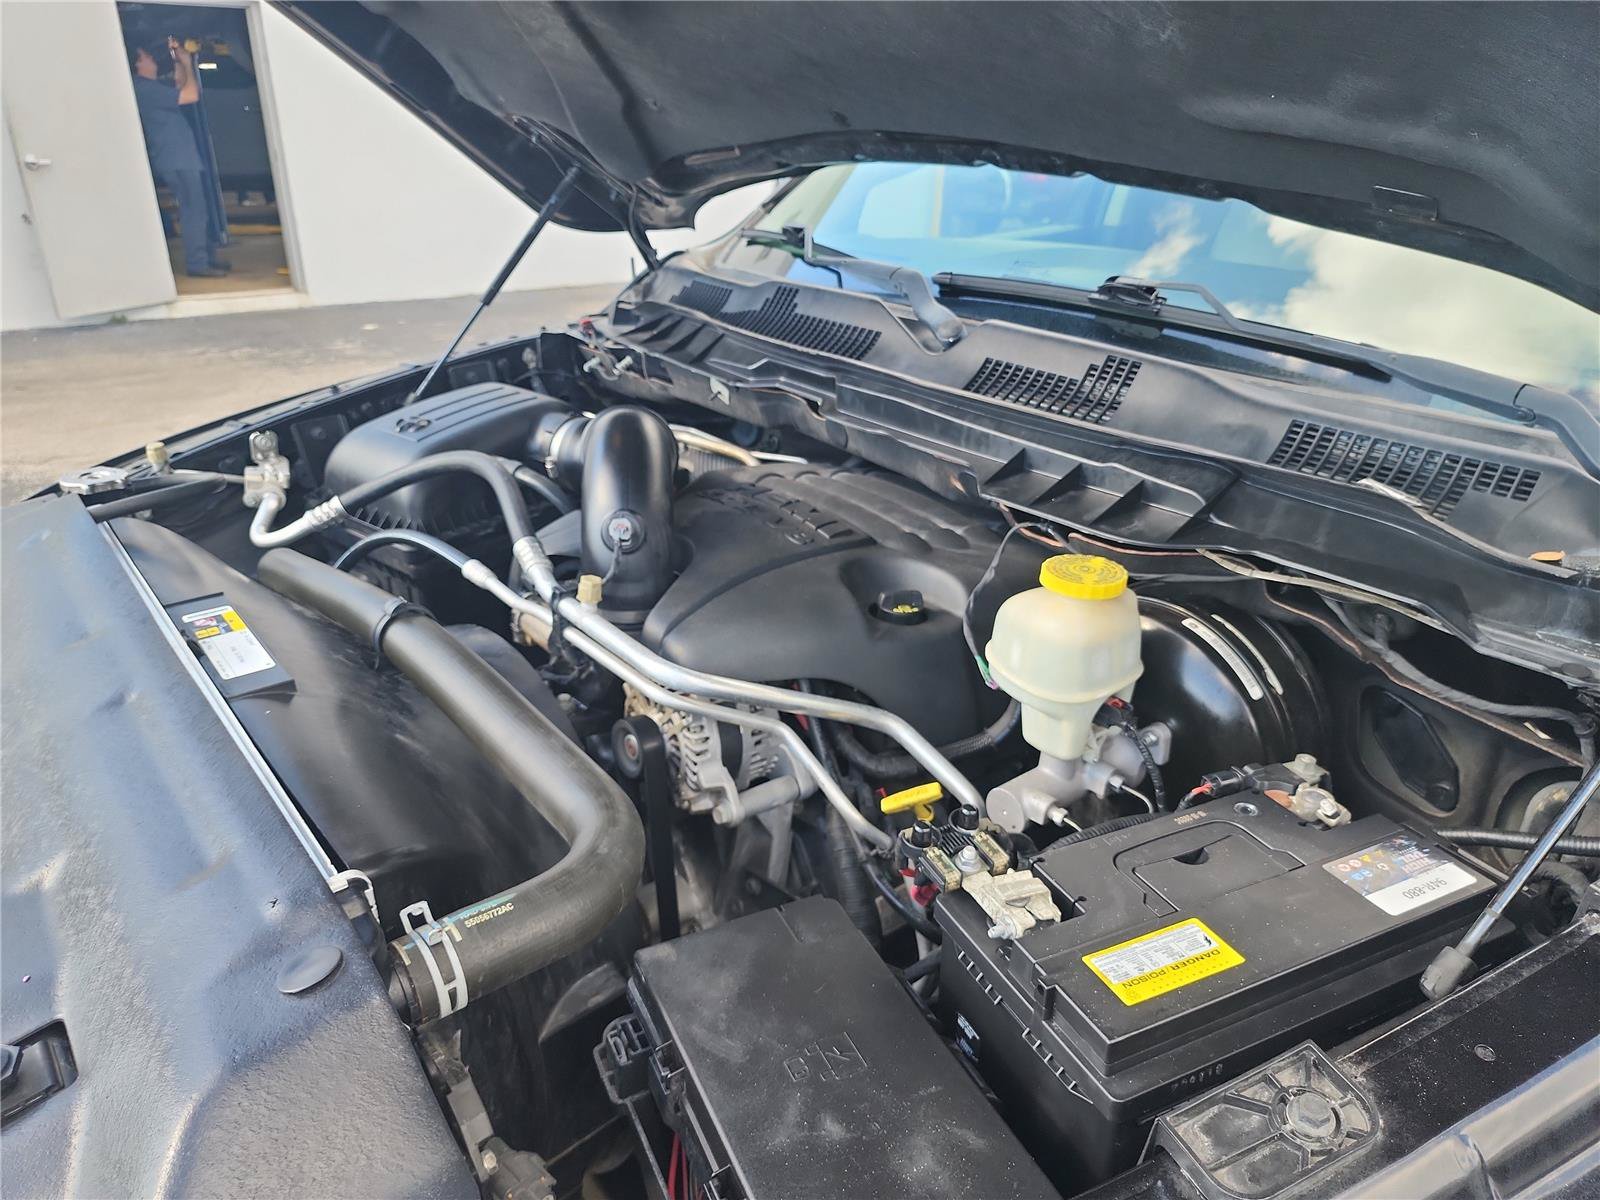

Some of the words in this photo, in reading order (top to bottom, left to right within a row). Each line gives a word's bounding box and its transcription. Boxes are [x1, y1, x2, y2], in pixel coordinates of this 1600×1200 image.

[1402, 880, 1447, 899] 94R-880
[1170, 949, 1221, 971] DANGER
[1122, 969, 1167, 989] POISON
